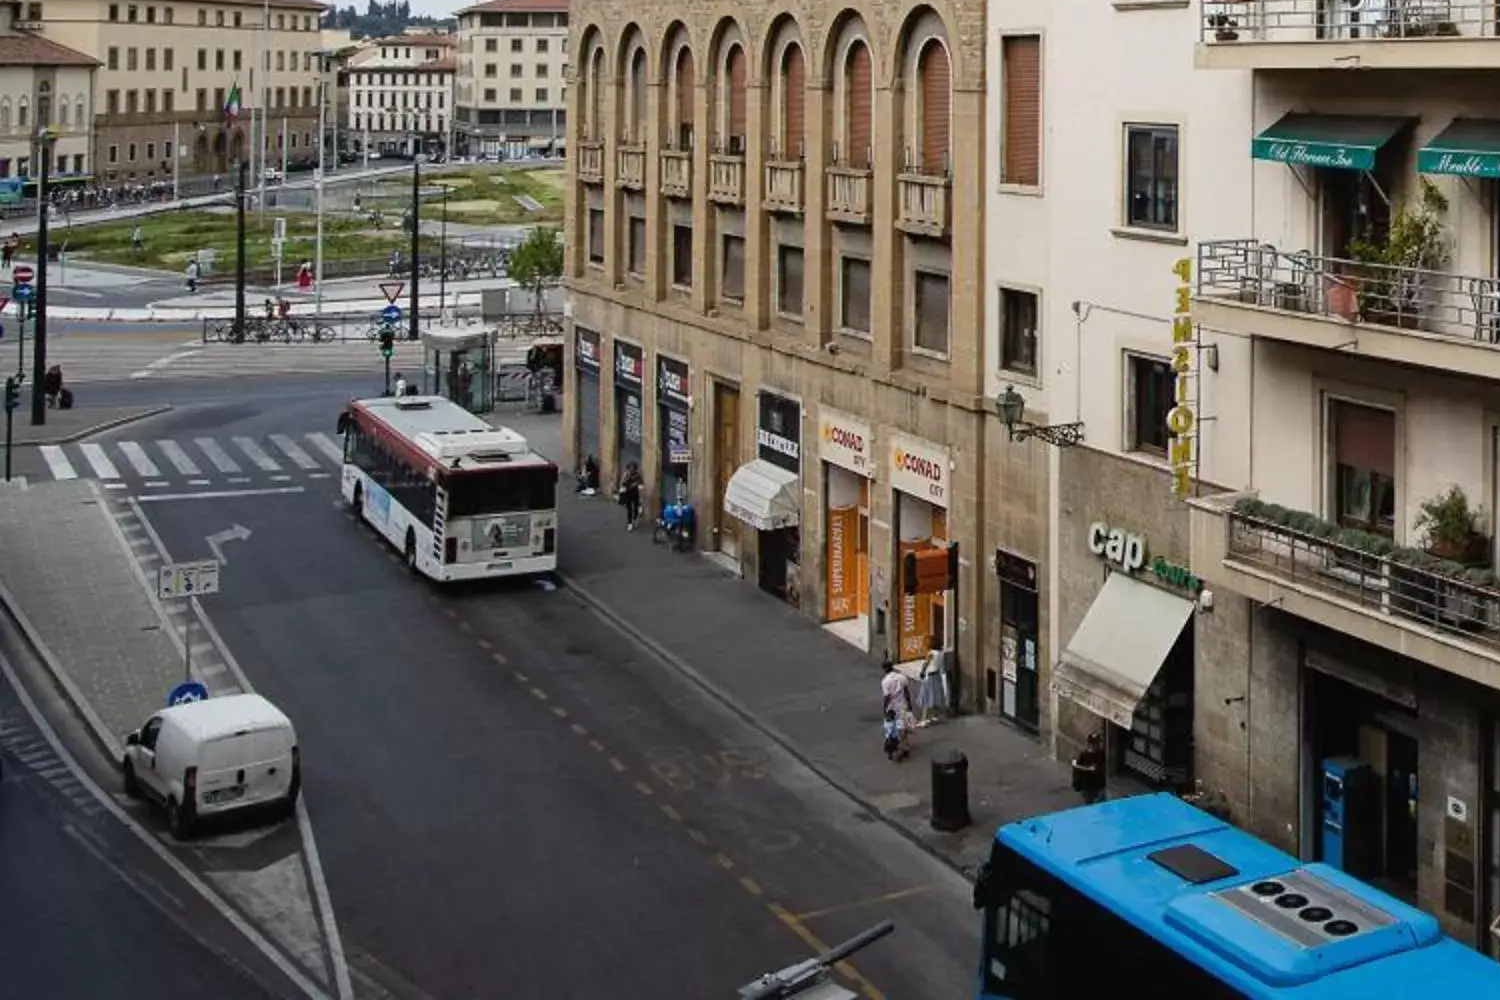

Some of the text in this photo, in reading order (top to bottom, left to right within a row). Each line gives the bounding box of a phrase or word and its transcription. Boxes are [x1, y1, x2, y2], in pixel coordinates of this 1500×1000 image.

[832, 427, 864, 453] CONAD
[904, 453, 941, 481] CONAD
[1088, 521, 1146, 573] cap
